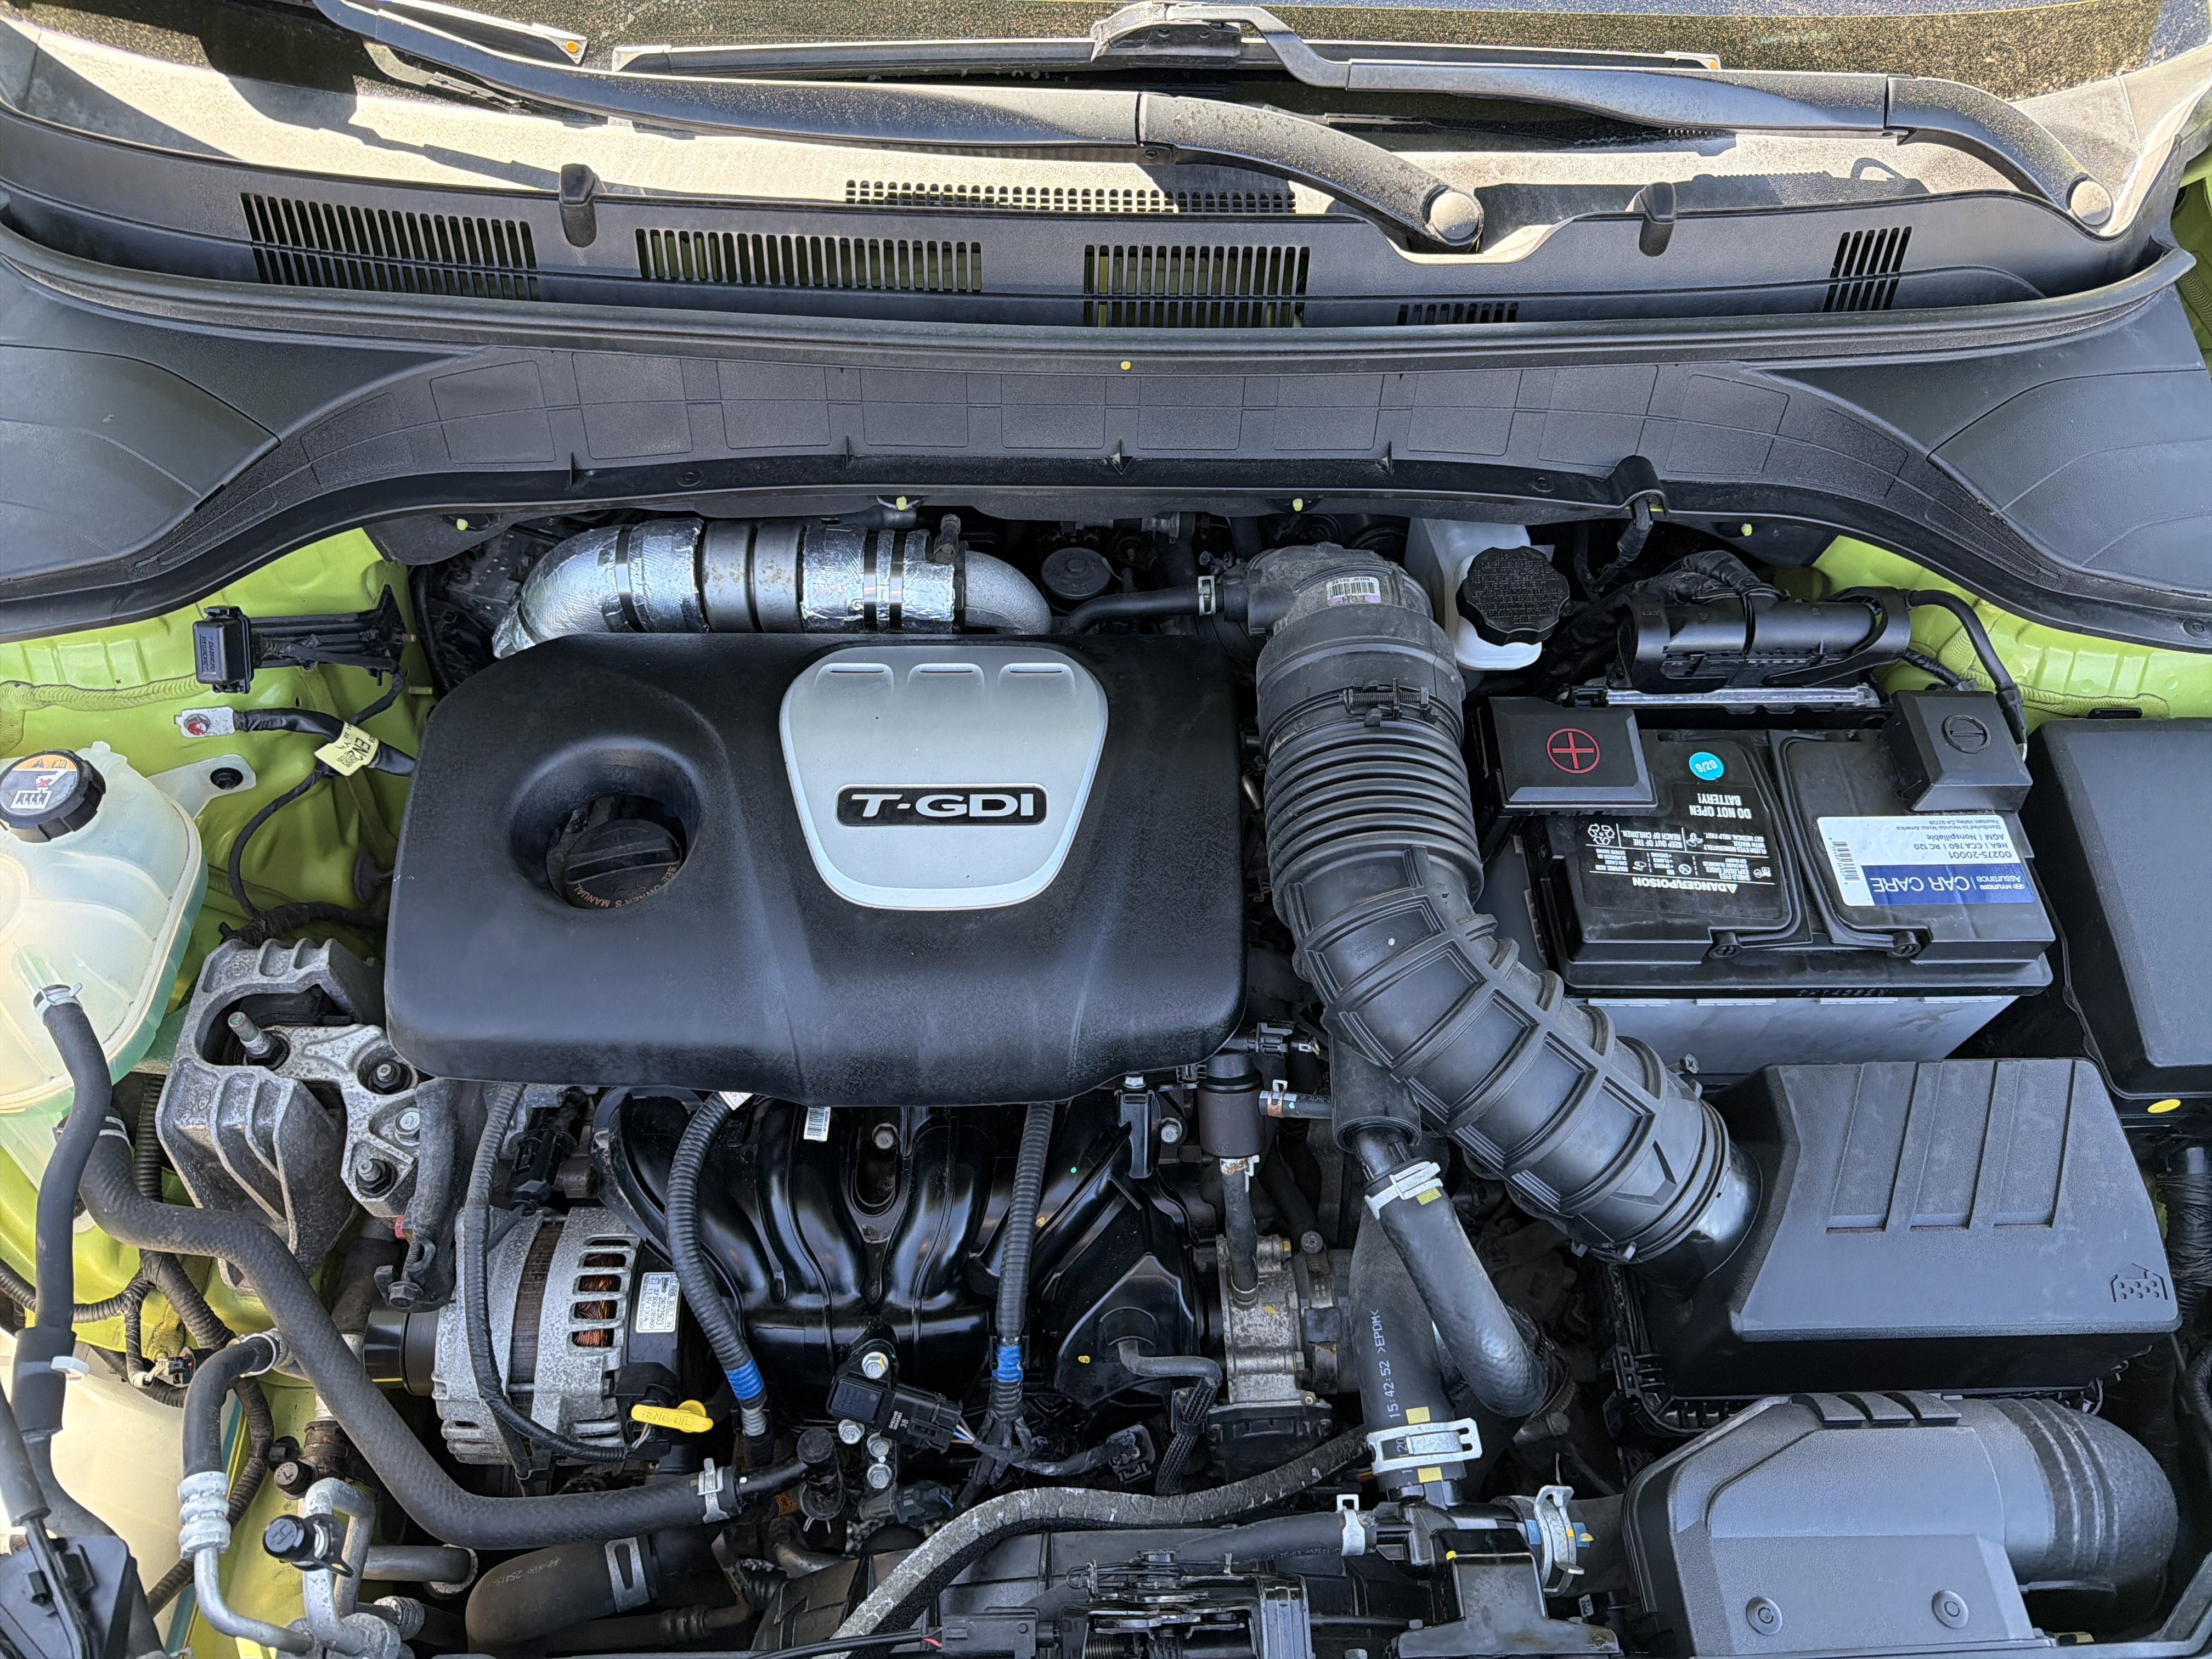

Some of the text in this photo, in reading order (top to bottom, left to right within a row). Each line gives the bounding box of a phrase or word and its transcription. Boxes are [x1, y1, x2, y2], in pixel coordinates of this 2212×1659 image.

[1695, 759, 1718, 772] 9/20
[850, 793, 1034, 819] T-GDI
[1697, 793, 1742, 806] BATTERY!
[1689, 805, 1752, 819] DO NOT OPEN
[1621, 830, 1652, 839] CHILDREN.
[1926, 833, 1976, 842] Nonspillable
[1668, 840, 1683, 849] KEEP
[1948, 850, 2012, 859] 00275-20001
[661, 866, 676, 882] SEE
[1632, 877, 1727, 892] DANGER/POISON
[1869, 876, 1970, 893] CAR CARE
[574, 883, 611, 909] MANUAL
[614, 884, 662, 909] OWNER'S
[656, 1277, 670, 1325] Valeo 2622503
[667, 1300, 675, 1317] BUILT
[1378, 1360, 1401, 1419] 15:42:52
[642, 1408, 693, 1427] ENG OIL
